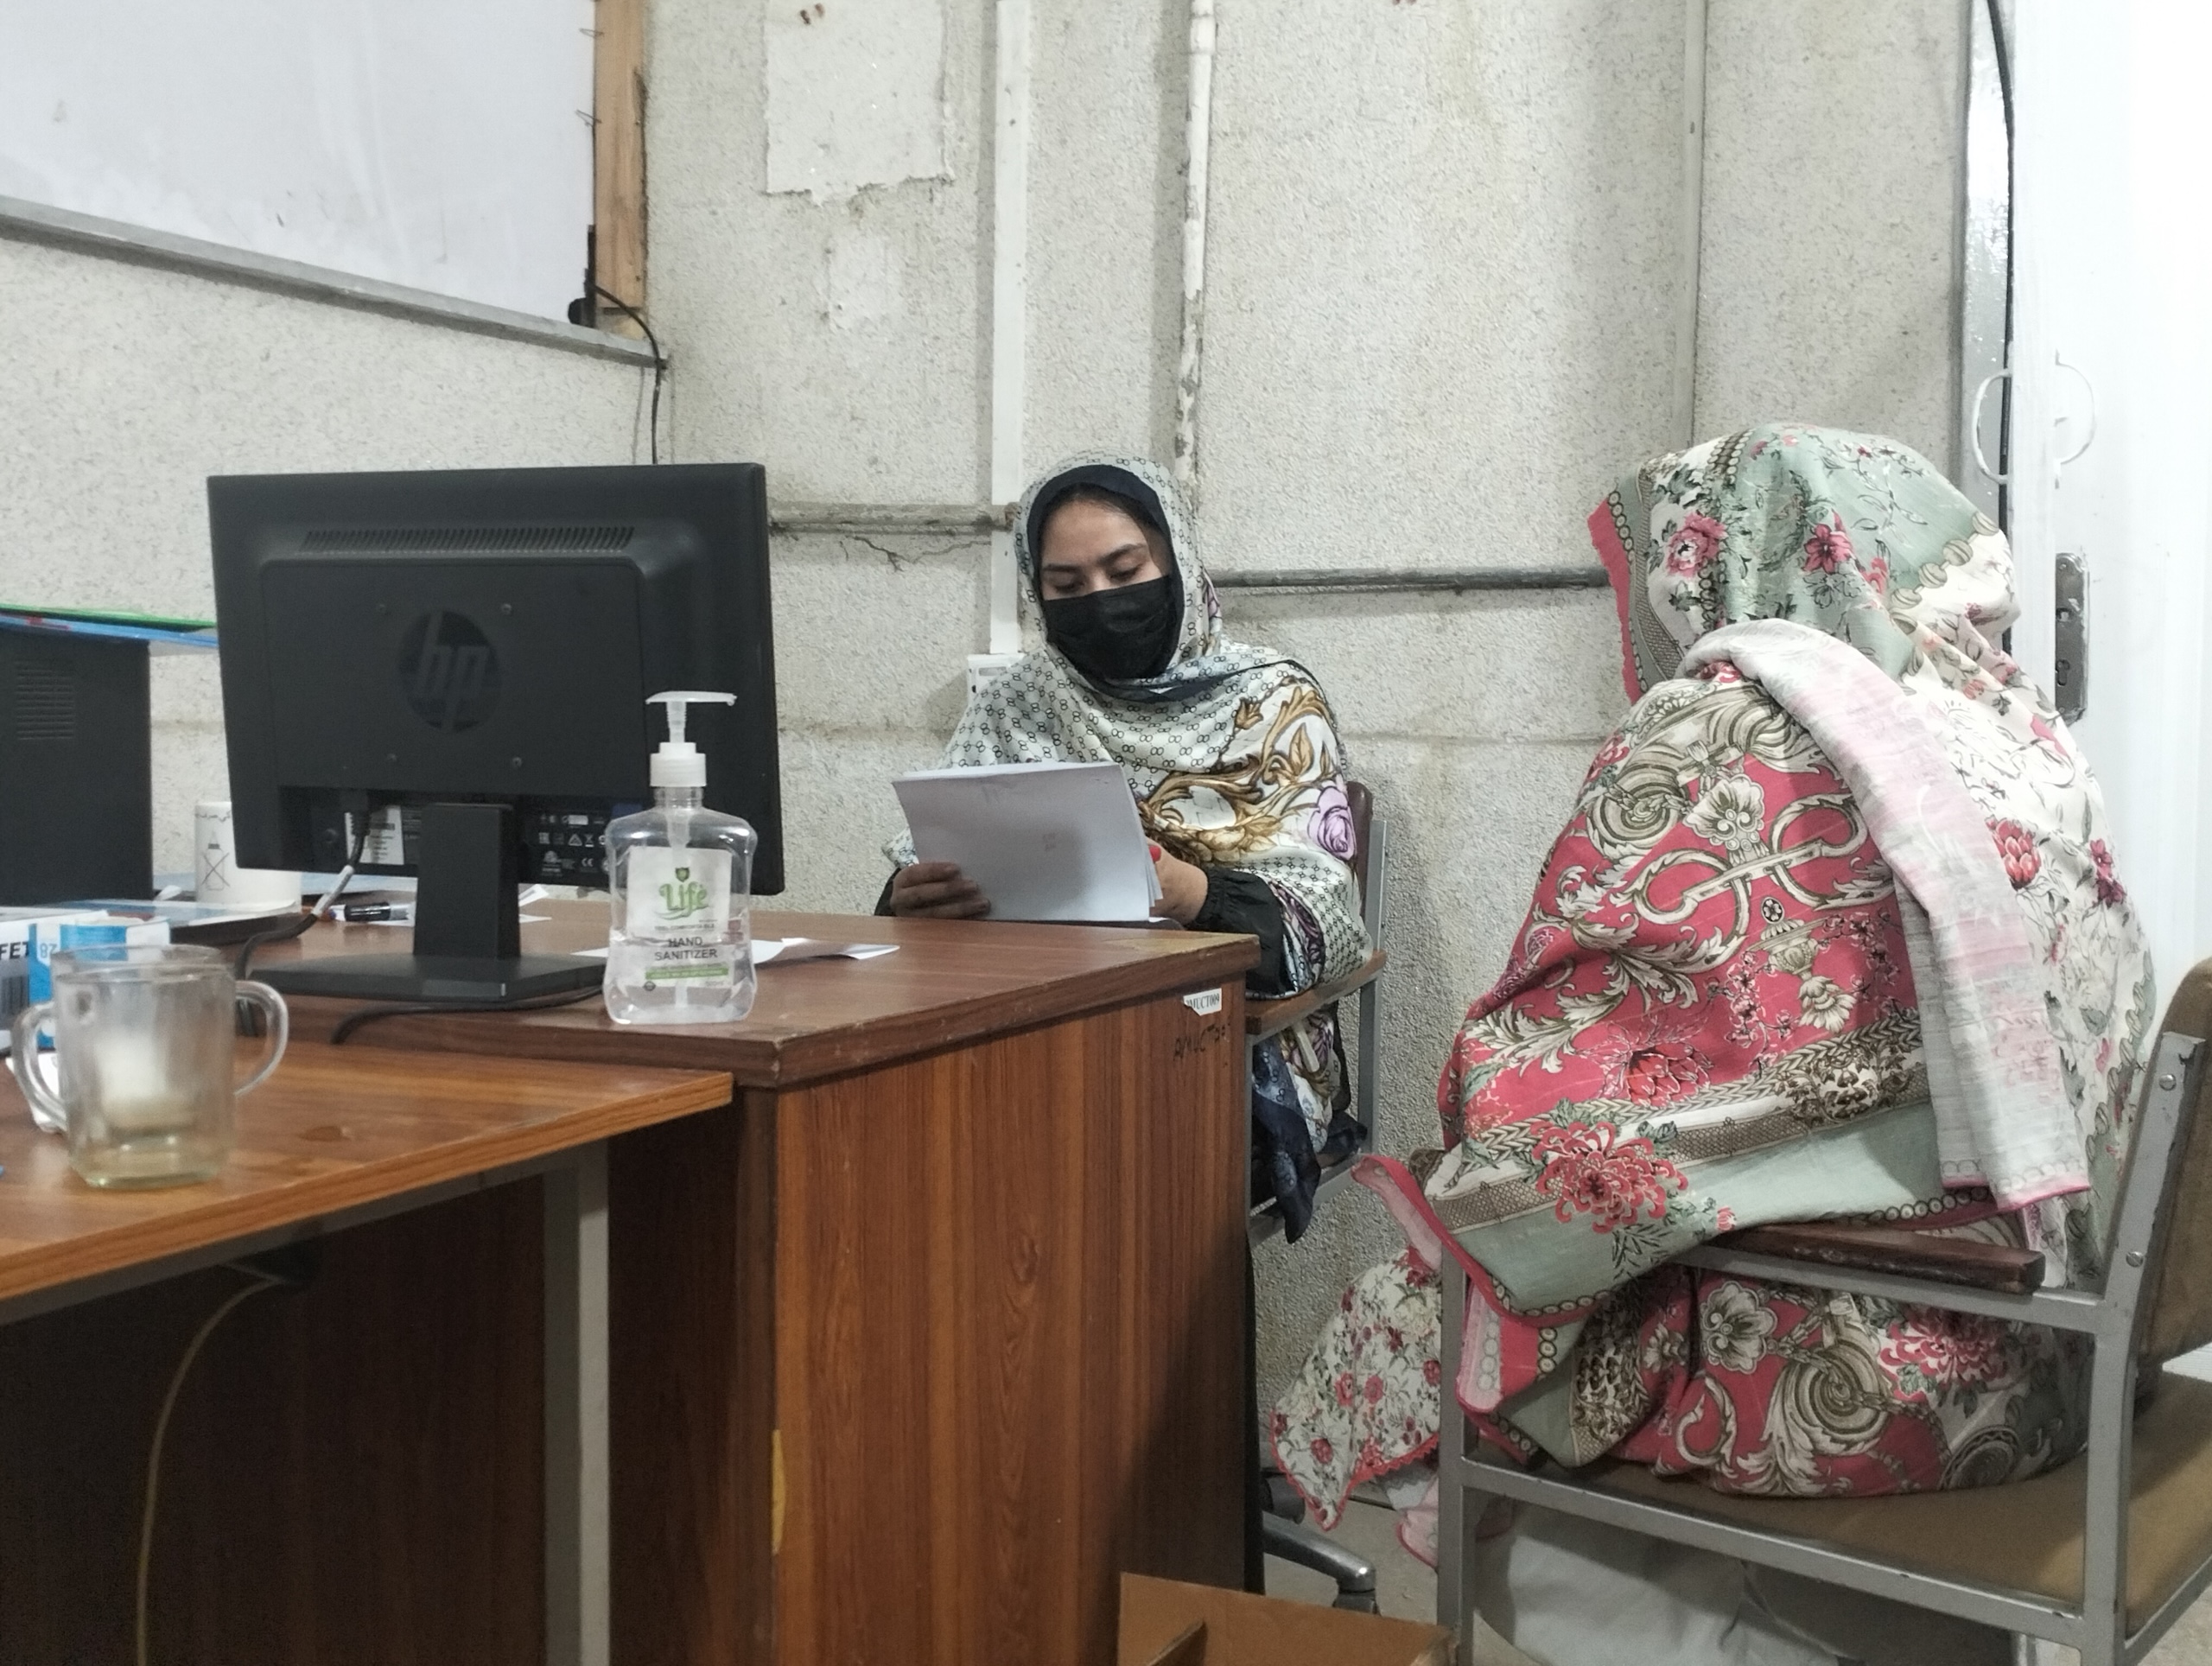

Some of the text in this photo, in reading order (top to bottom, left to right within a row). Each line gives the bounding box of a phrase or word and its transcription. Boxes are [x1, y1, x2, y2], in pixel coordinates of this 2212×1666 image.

[658, 881, 709, 919] Life
[667, 936, 703, 948] HAND
[654, 948, 718, 962] SANITIZER
